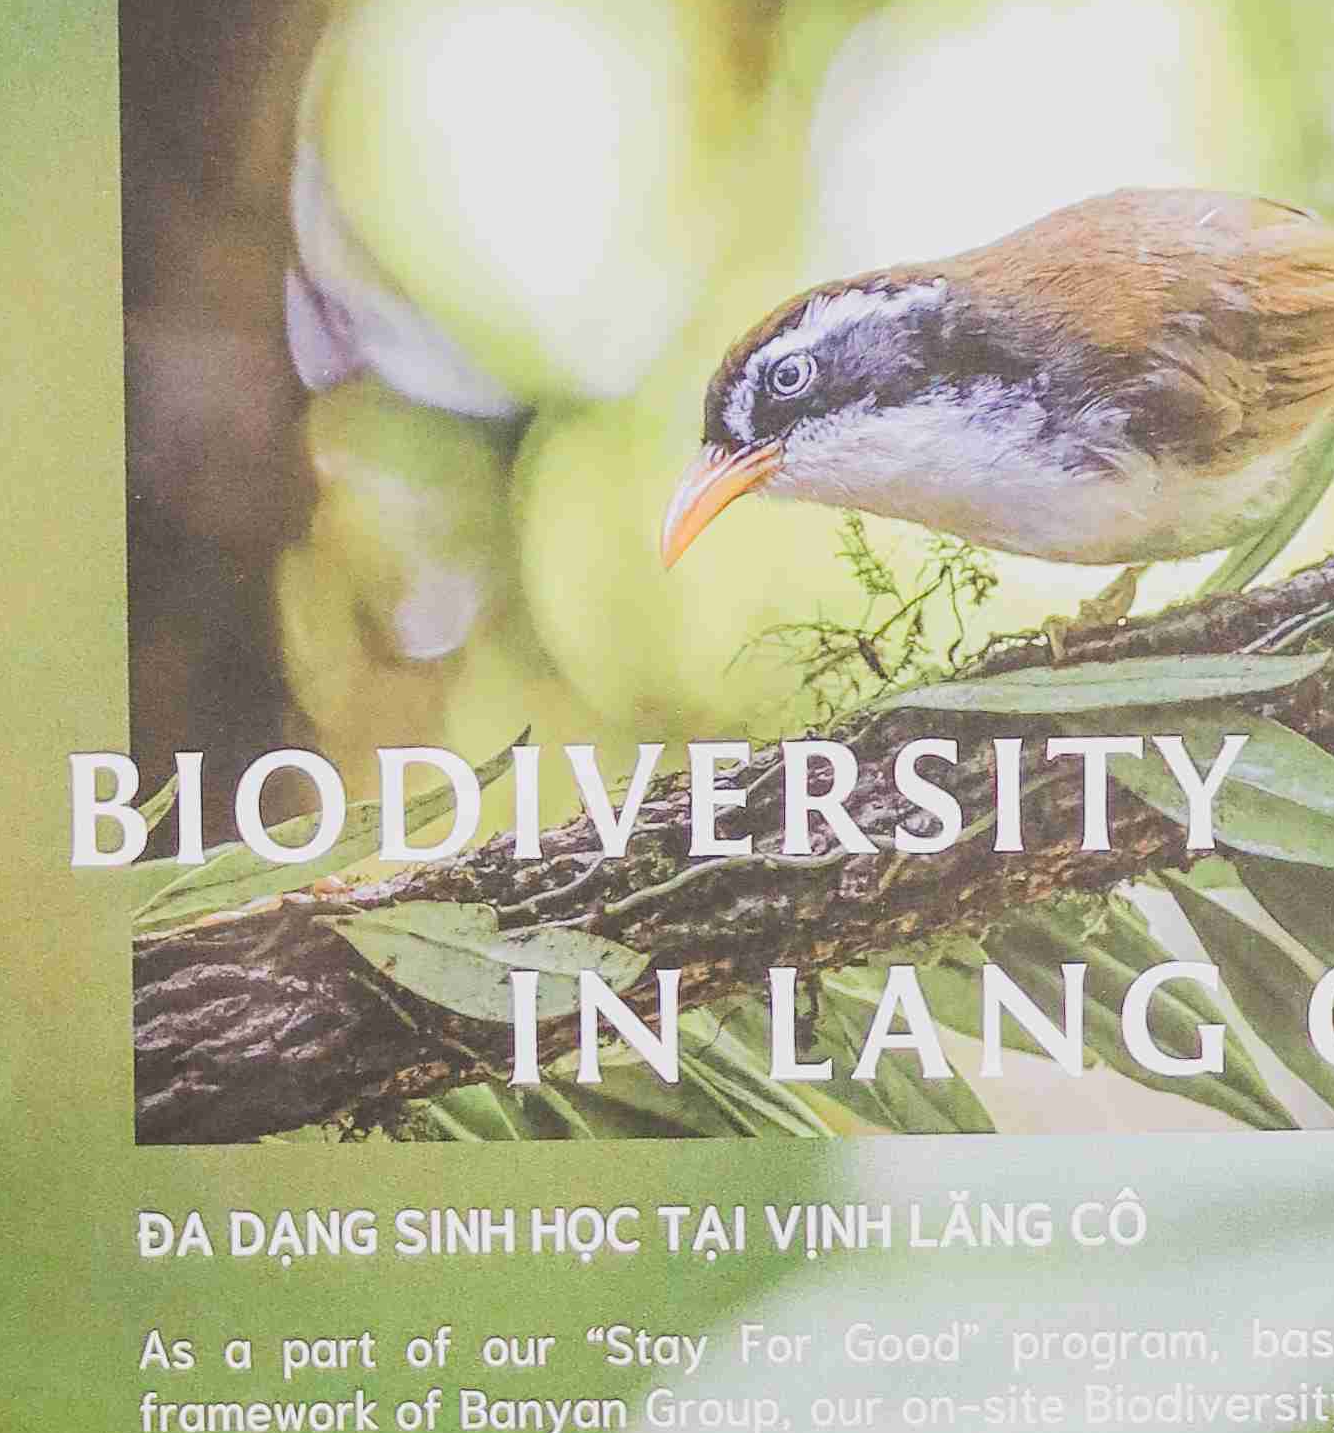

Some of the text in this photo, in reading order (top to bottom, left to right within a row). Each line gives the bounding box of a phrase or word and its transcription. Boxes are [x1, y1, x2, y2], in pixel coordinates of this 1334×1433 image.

[69, 735, 1250, 867] BIODIVERSITY
[508, 967, 681, 1087] IN
[768, 960, 1227, 1081] LANG
[136, 1186, 1149, 1271] ĐA DẠNG SINH HỌC TẠI VỊNH LĂNG CÔ
[138, 1329, 196, 1372] As
[222, 1338, 253, 1373] a
[281, 1330, 377, 1383] part
[404, 1325, 454, 1371] of
[481, 1335, 557, 1370] our
[739, 1321, 813, 1367] For
[1005, 1326, 1228, 1374] program,
[394, 1387, 444, 1433] of
[809, 1396, 885, 1433] our
[900, 1384, 1069, 1432] on-site
